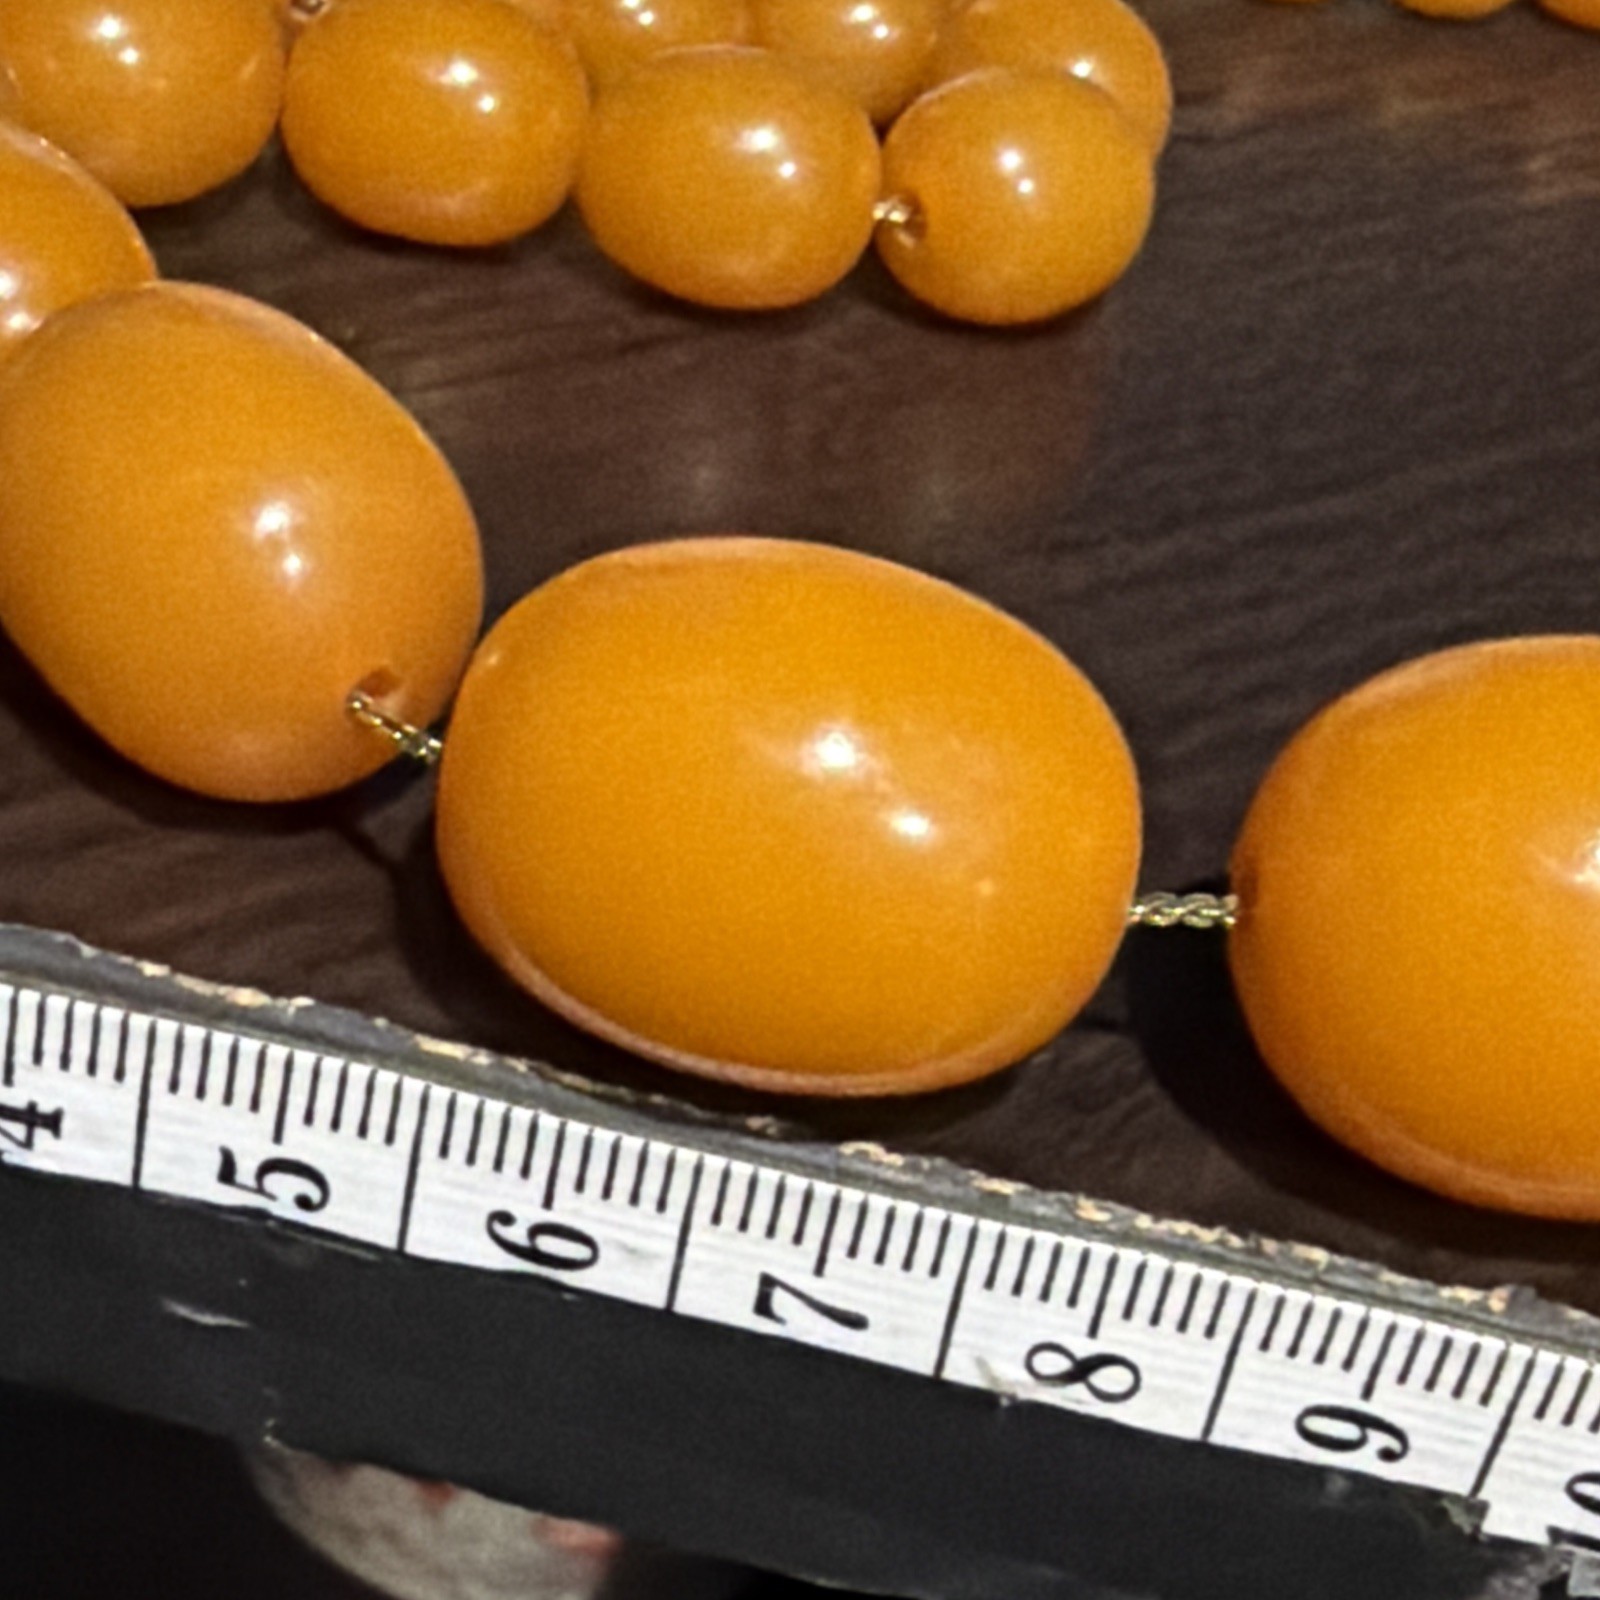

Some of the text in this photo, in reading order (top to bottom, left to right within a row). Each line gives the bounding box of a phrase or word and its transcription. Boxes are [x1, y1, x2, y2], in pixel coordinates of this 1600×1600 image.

[217, 1146, 331, 1213] 5
[486, 1209, 600, 1271] 6
[753, 1272, 869, 1330] 7
[1024, 1342, 1141, 1402] 8
[1295, 1404, 1409, 1463] 9
